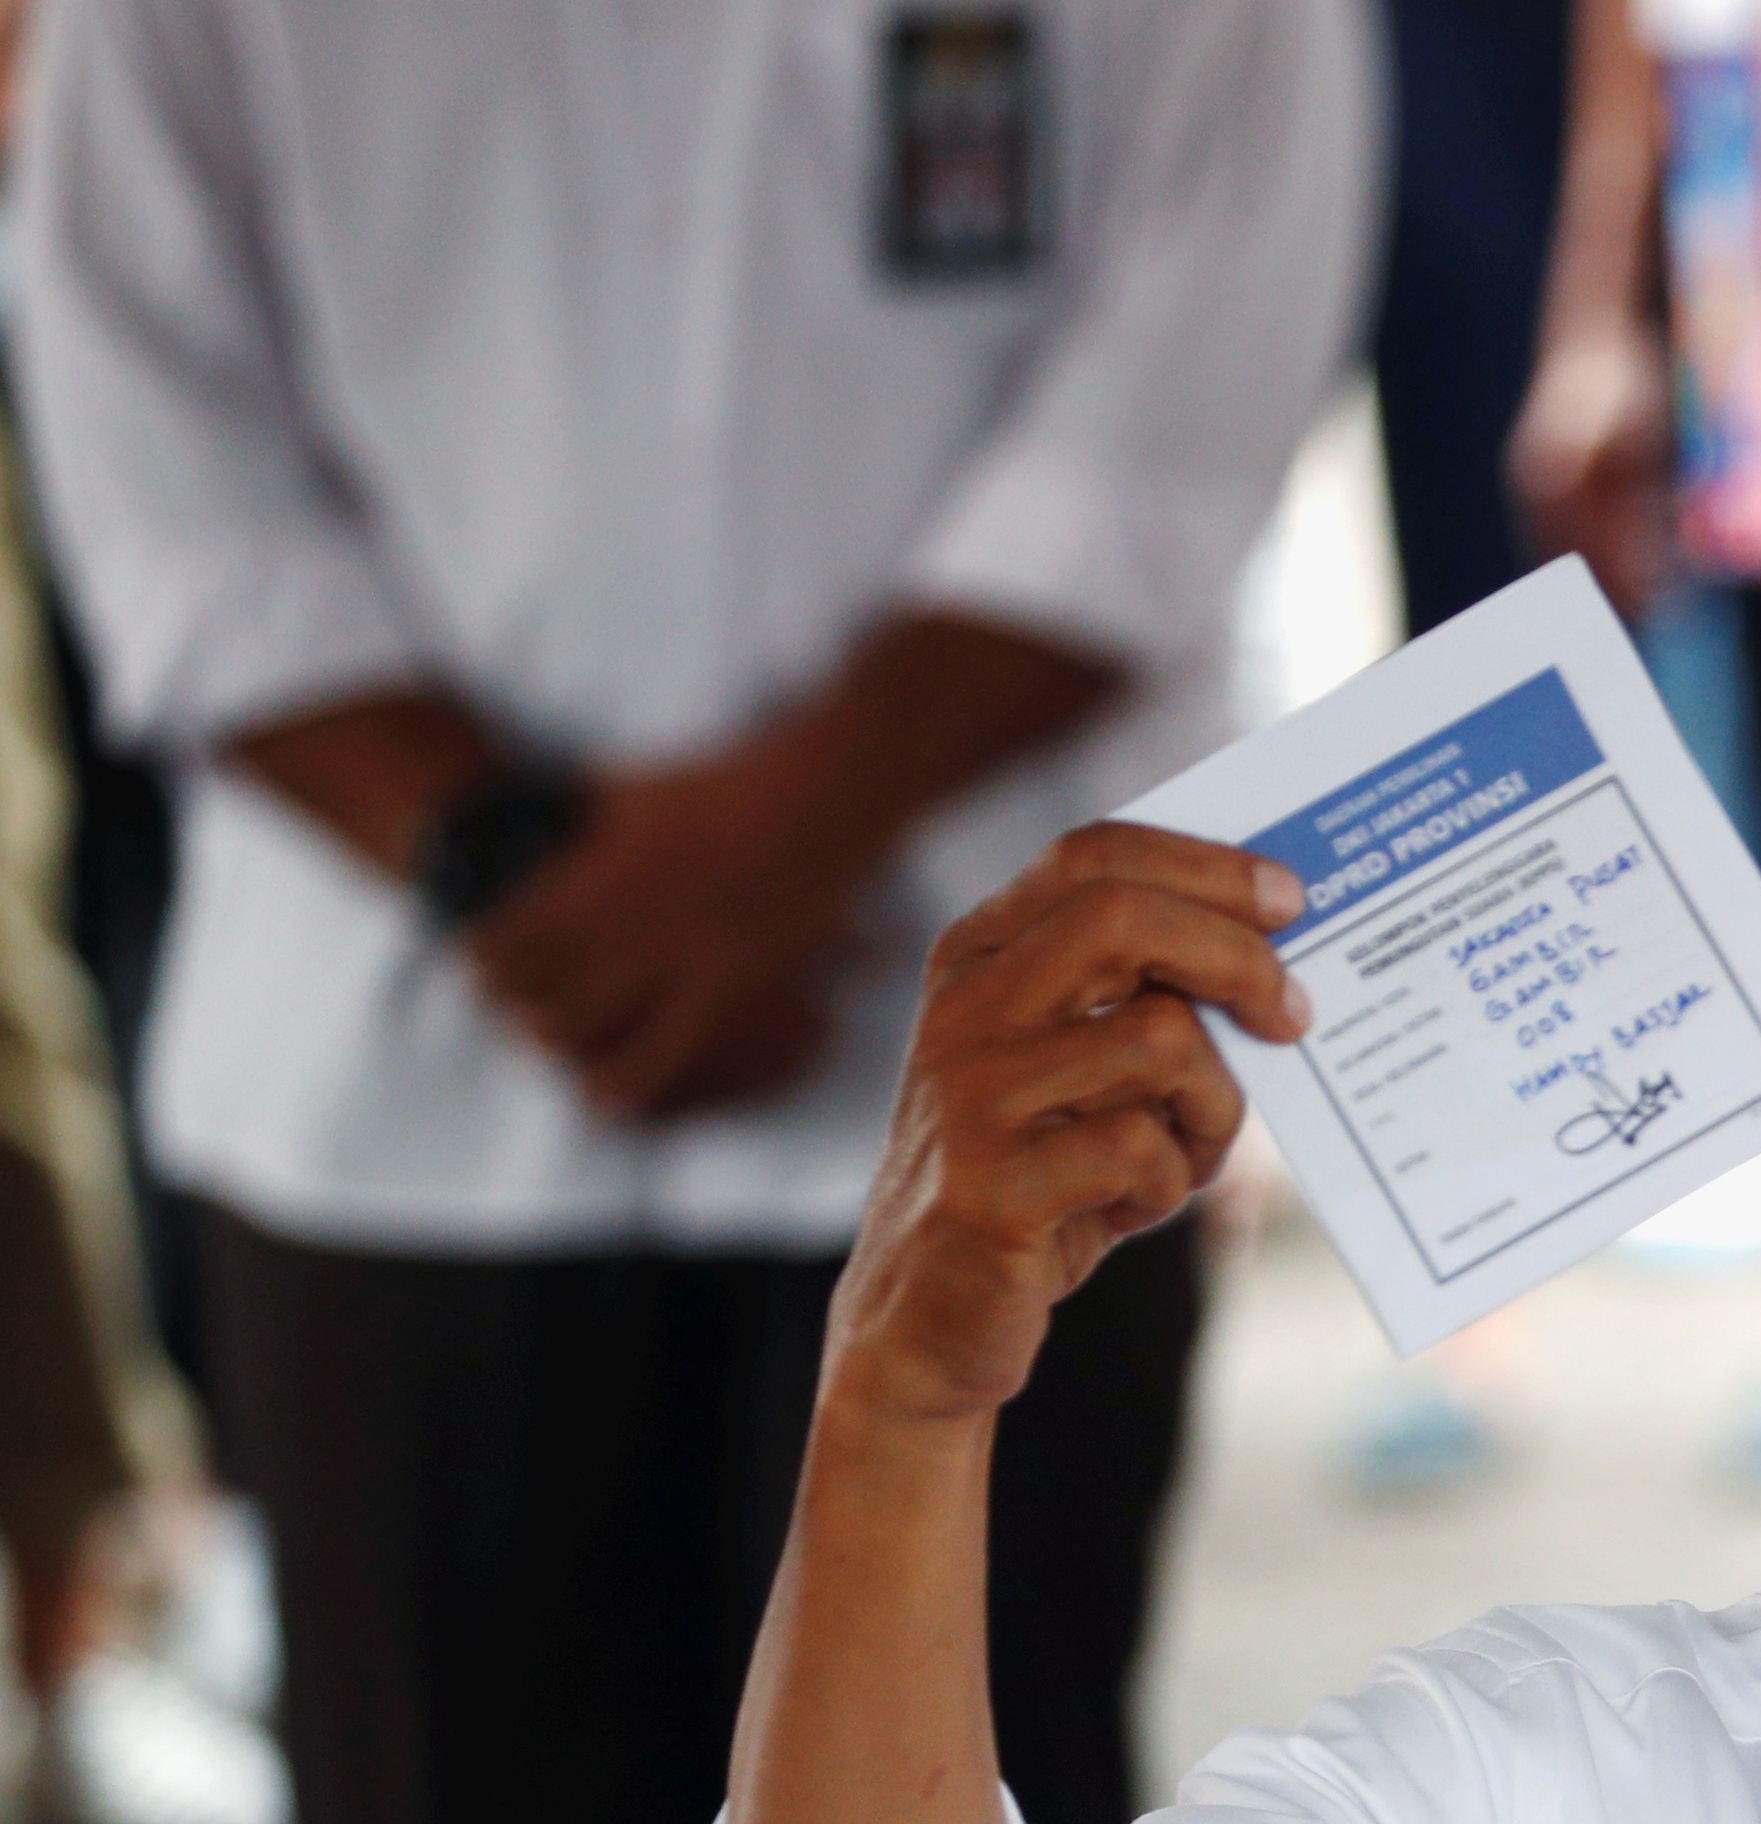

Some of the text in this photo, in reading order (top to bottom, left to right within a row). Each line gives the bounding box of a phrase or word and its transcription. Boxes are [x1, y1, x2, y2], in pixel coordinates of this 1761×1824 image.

[1304, 770, 1528, 911] DPRD PROVINSI
[1369, 777, 1456, 836] JAKARTA
[1467, 922, 1593, 994] GAMBIR
[1483, 944, 1616, 1023] GAMBIR
